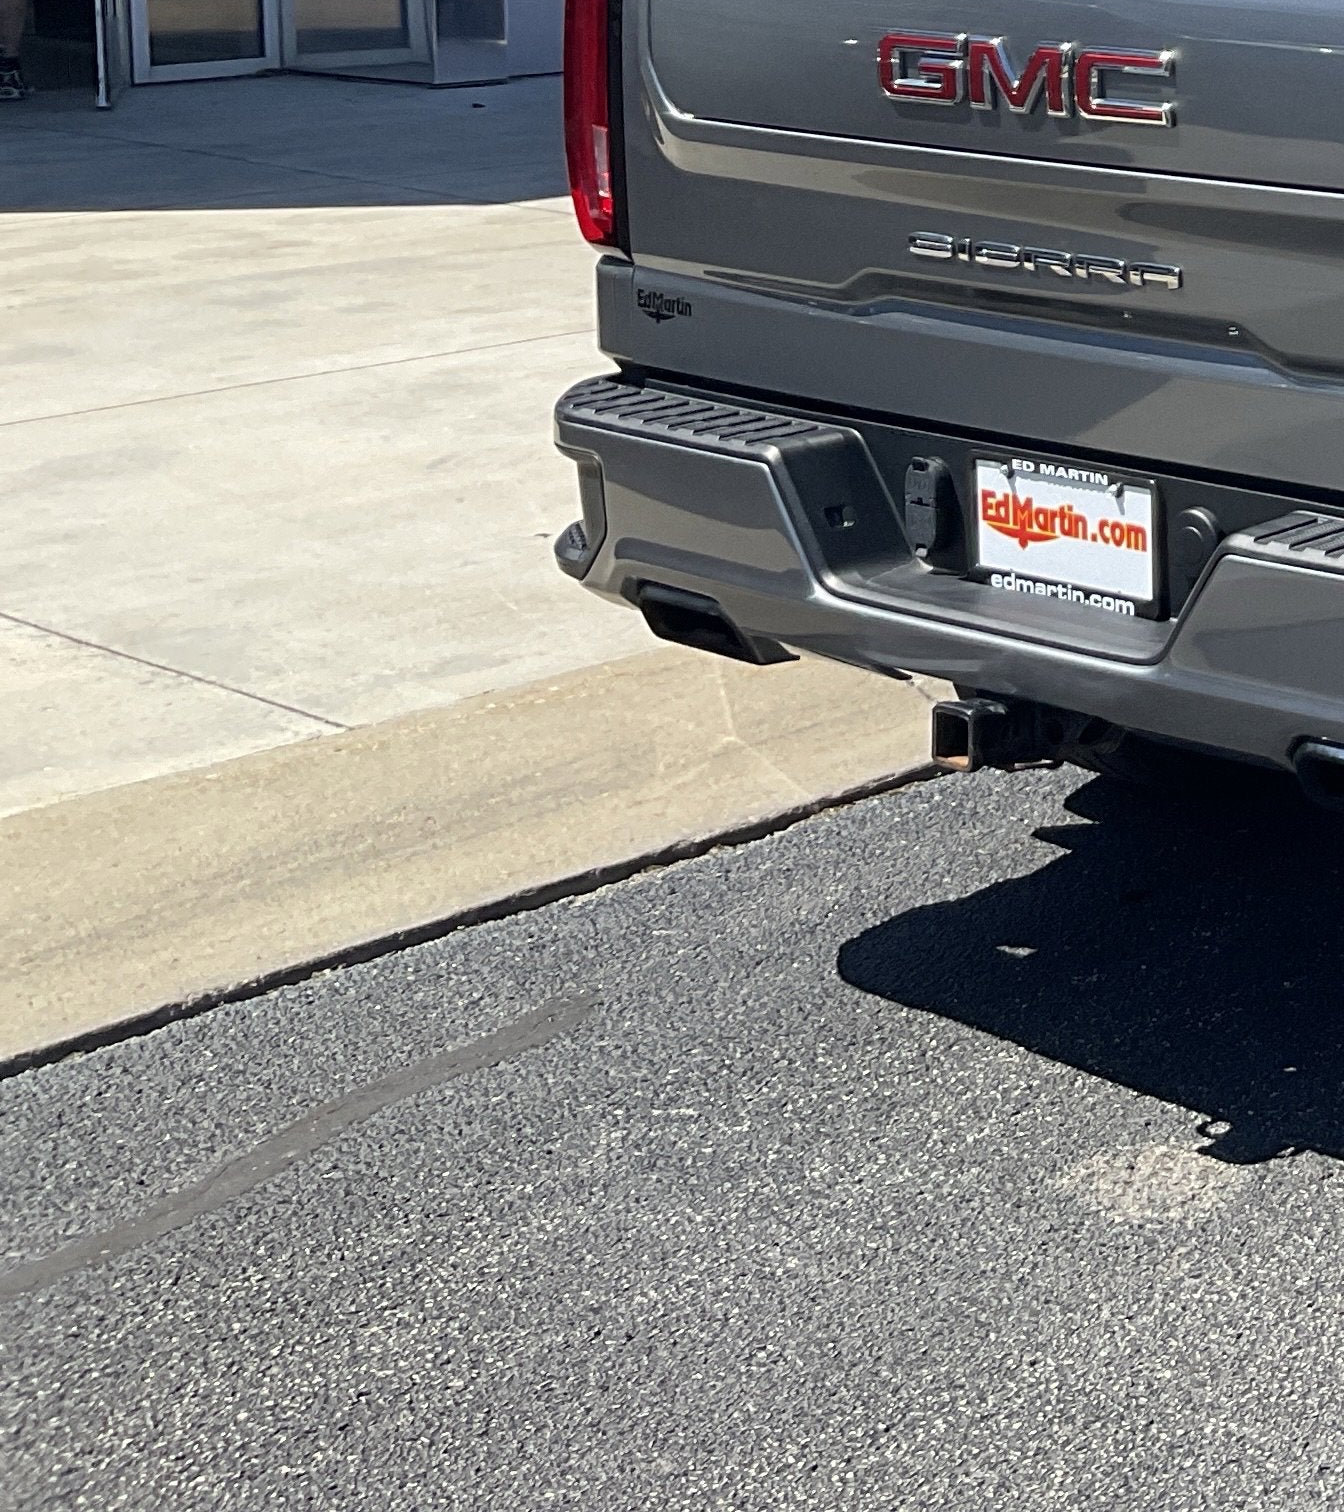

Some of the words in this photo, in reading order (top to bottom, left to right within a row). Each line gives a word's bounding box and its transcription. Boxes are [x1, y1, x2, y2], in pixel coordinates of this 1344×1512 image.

[876, 30, 1178, 128] GMC
[908, 230, 1183, 290] SIERRA
[1011, 458, 1035, 472] ED
[1039, 463, 1109, 486] MARTIN
[991, 573, 1135, 615] edmartin.com
